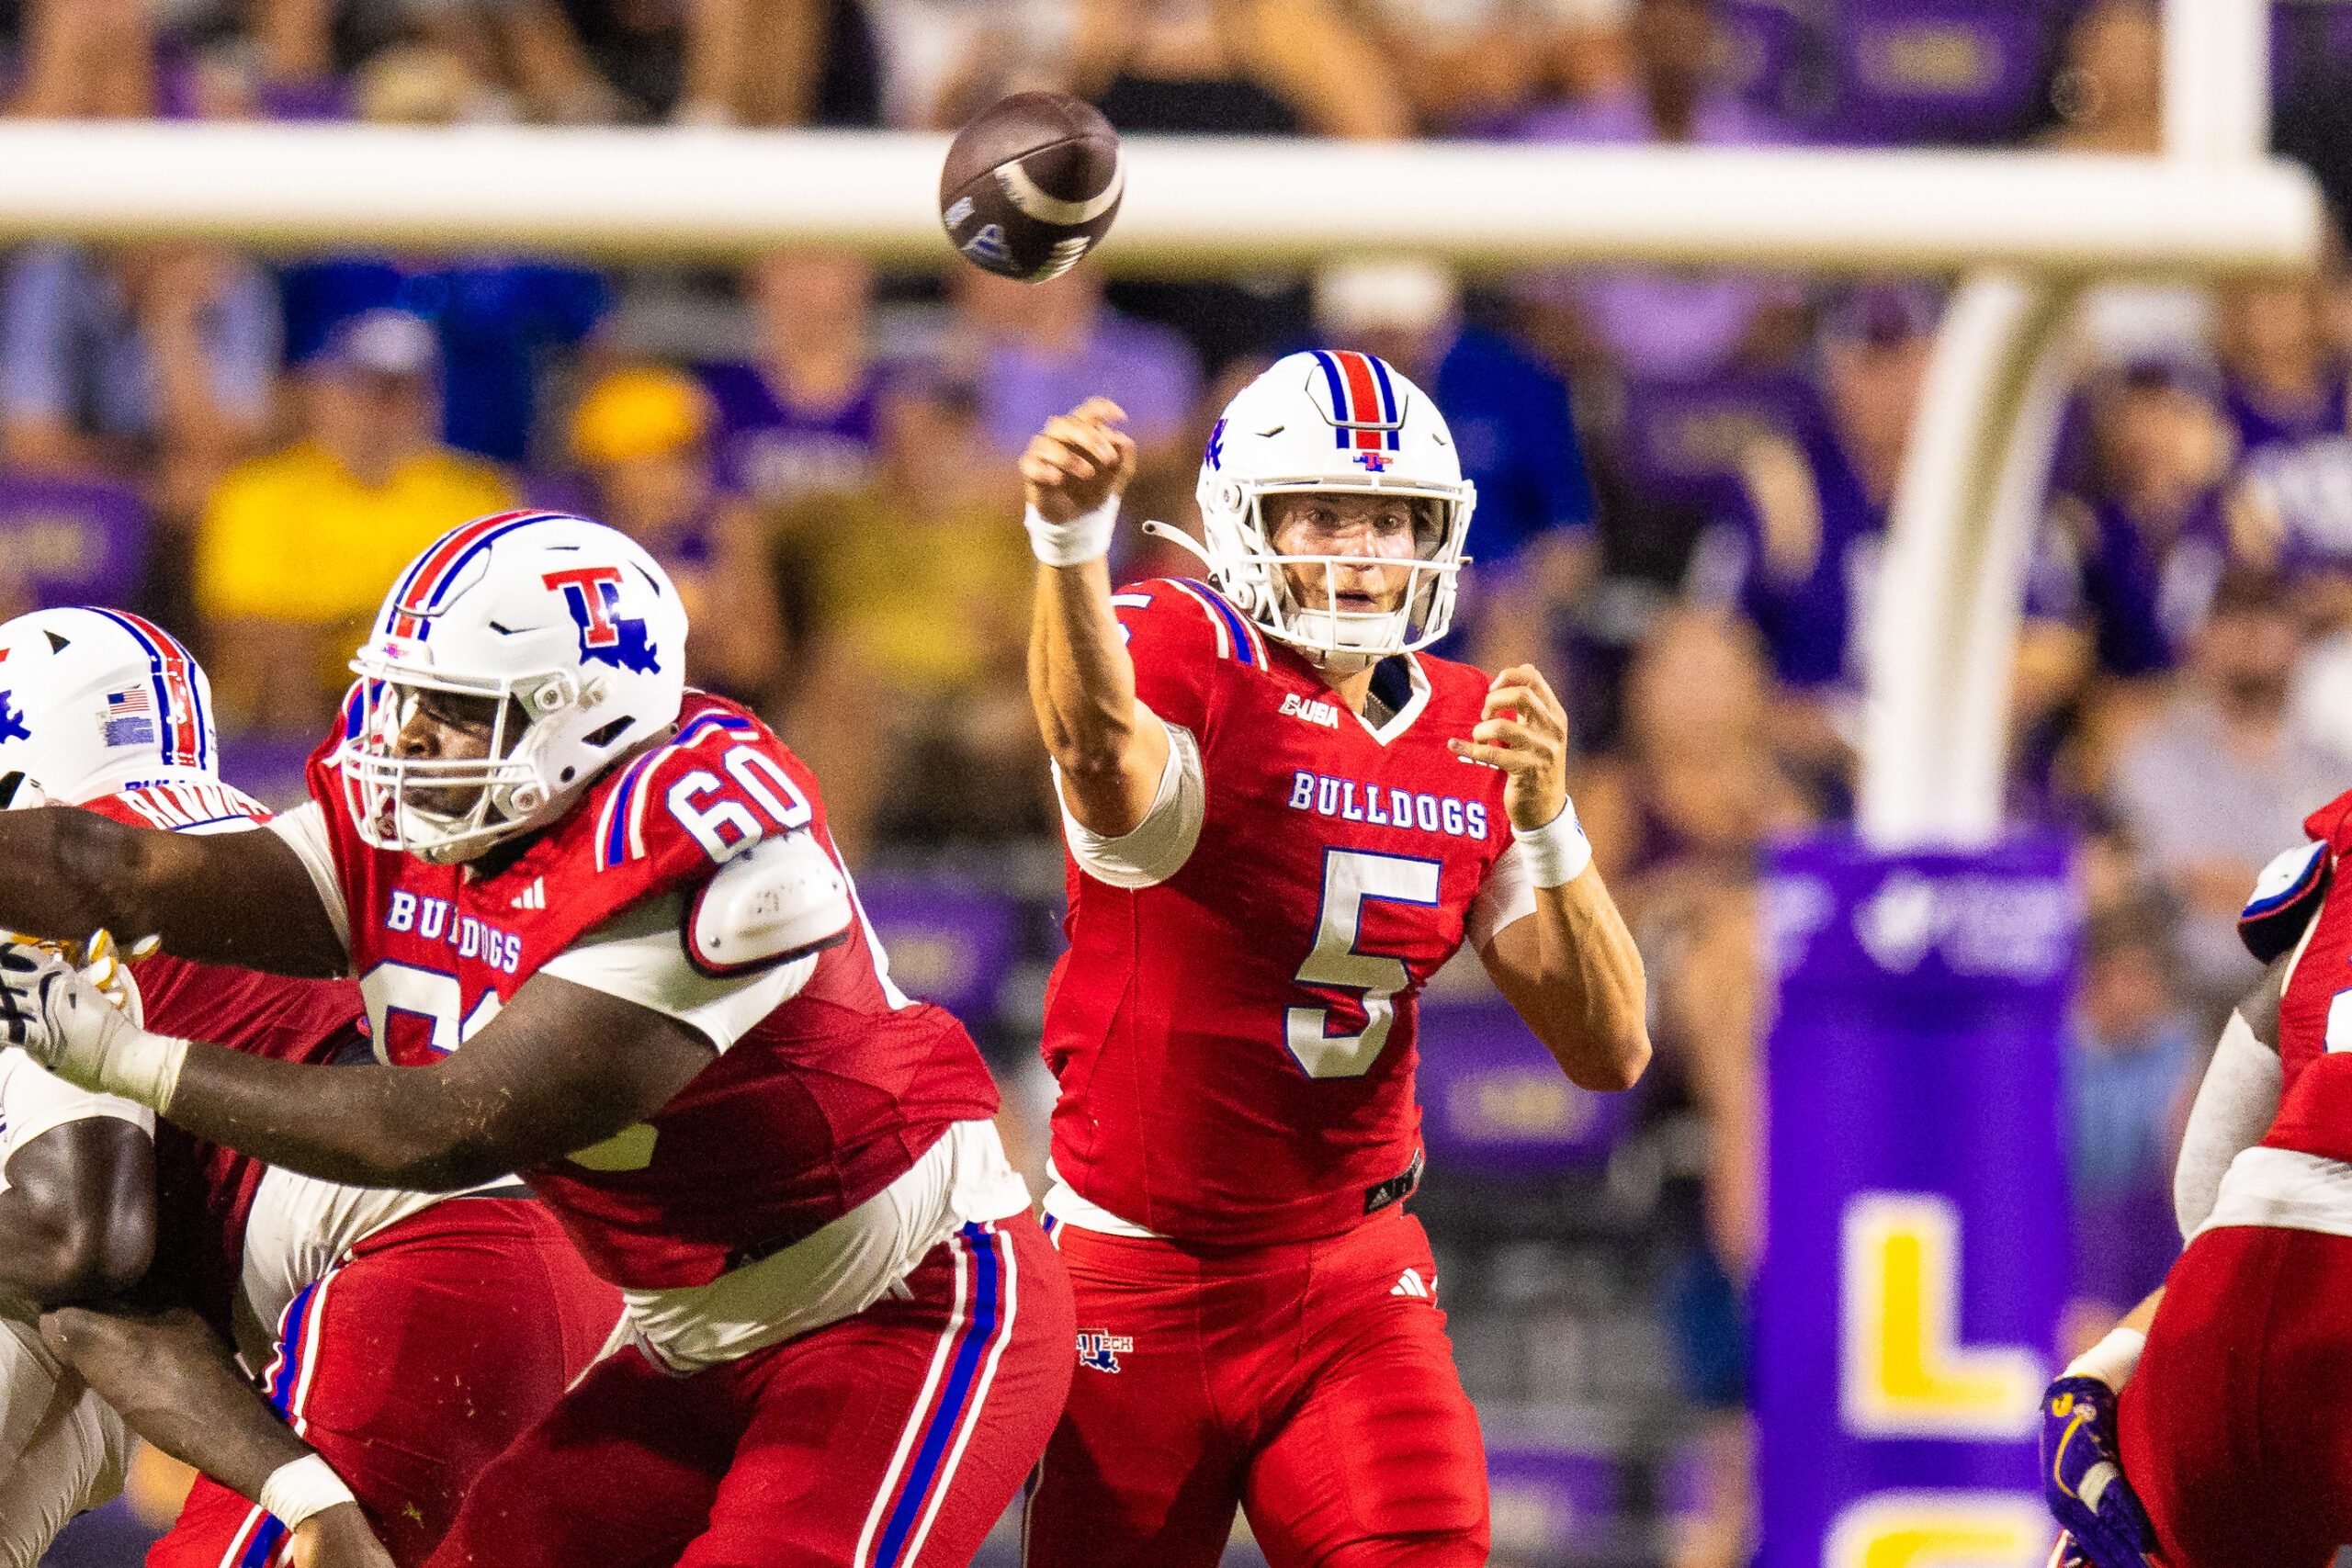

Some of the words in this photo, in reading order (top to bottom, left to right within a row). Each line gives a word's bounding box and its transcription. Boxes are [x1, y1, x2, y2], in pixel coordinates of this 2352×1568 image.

[664, 743, 814, 865] 60
[1288, 769, 1488, 841] BULLDOGS
[384, 887, 523, 976] BUDOGS
[1282, 845, 1442, 1080] 5
